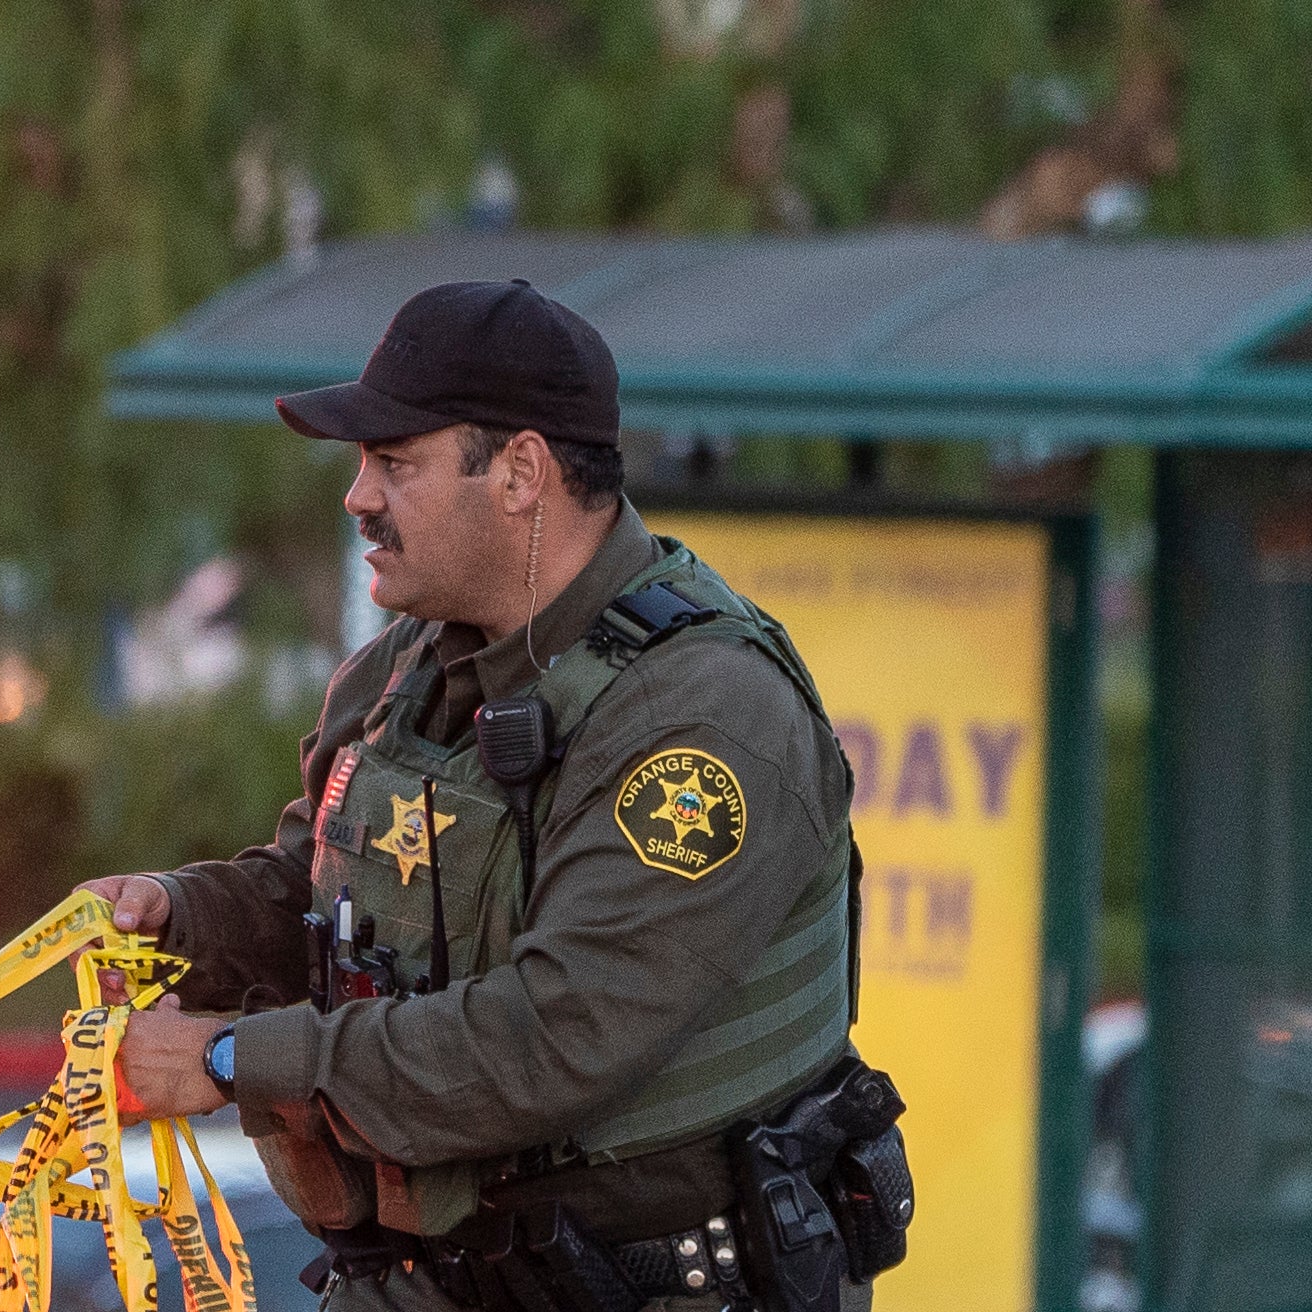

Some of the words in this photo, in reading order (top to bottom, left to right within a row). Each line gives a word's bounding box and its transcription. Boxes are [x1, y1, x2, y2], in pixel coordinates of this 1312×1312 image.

[622, 757, 694, 807] ORANGE
[702, 764, 743, 841] COUNTY
[646, 837, 707, 868] SHERIFF
